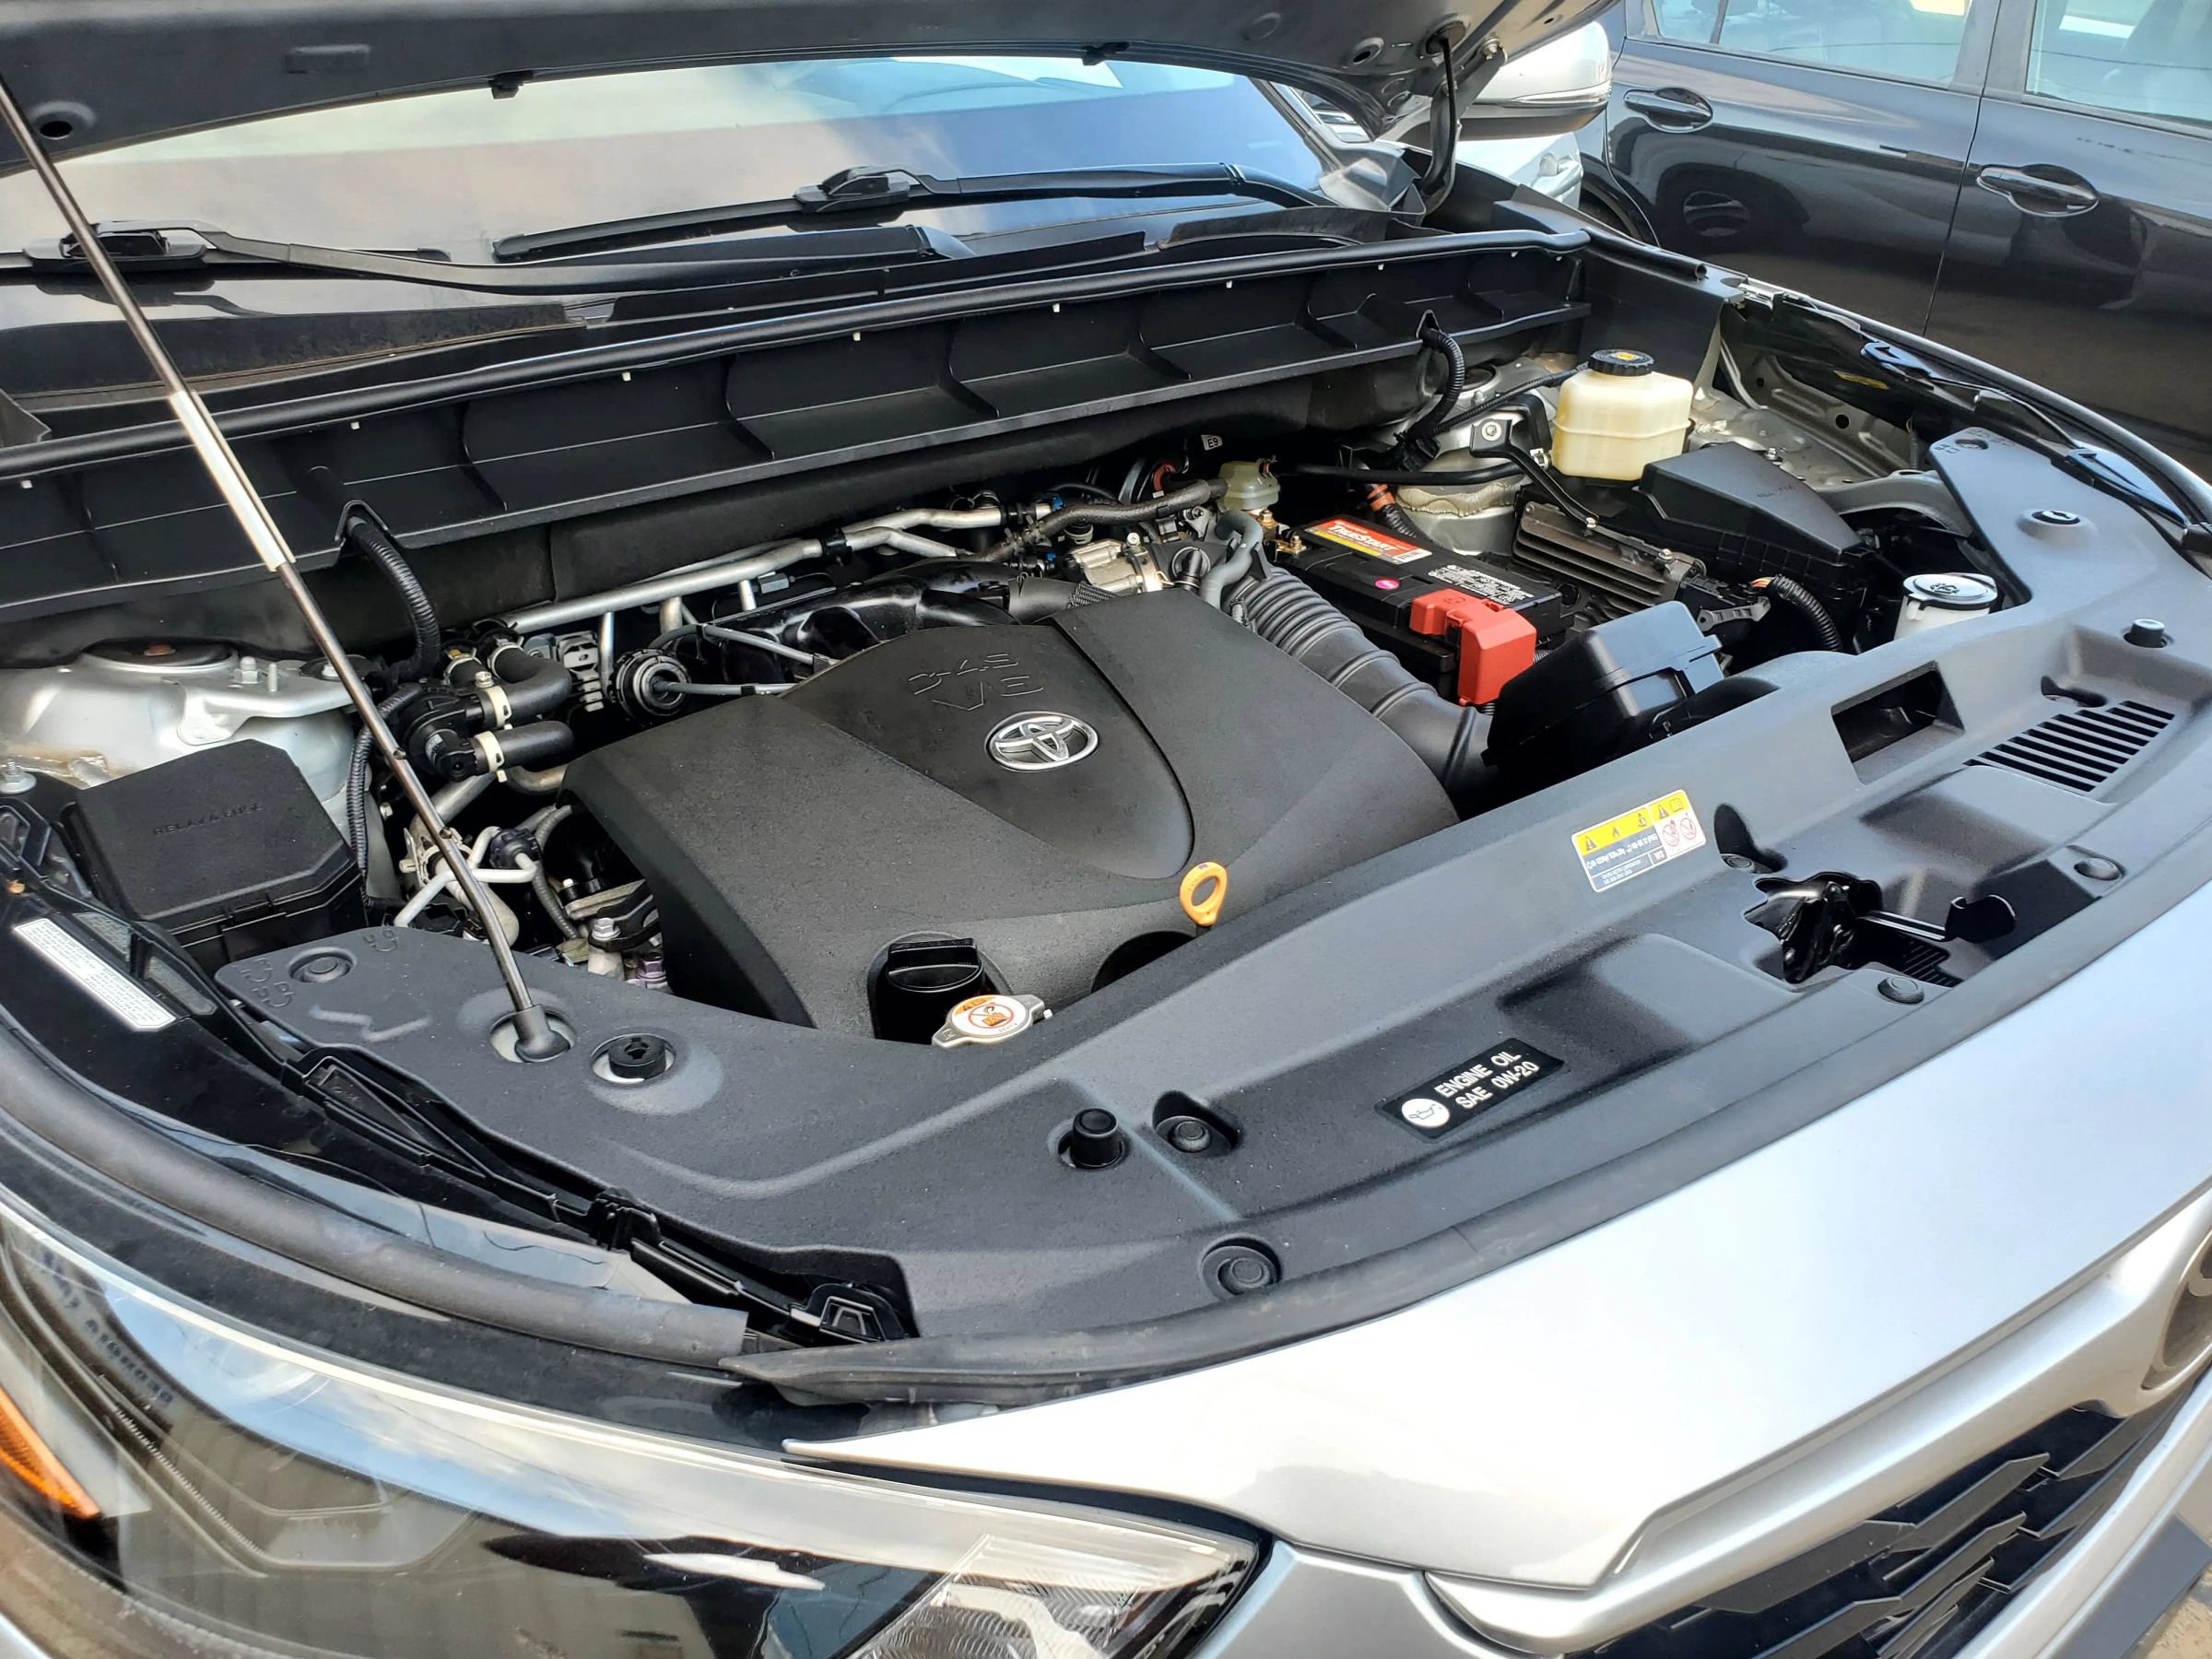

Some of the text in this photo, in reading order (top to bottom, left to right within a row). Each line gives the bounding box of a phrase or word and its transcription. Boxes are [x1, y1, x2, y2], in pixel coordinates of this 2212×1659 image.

[1434, 1051, 1522, 1098] ENGINE OIL
[1455, 1061, 1540, 1109] SAE 0W-20
